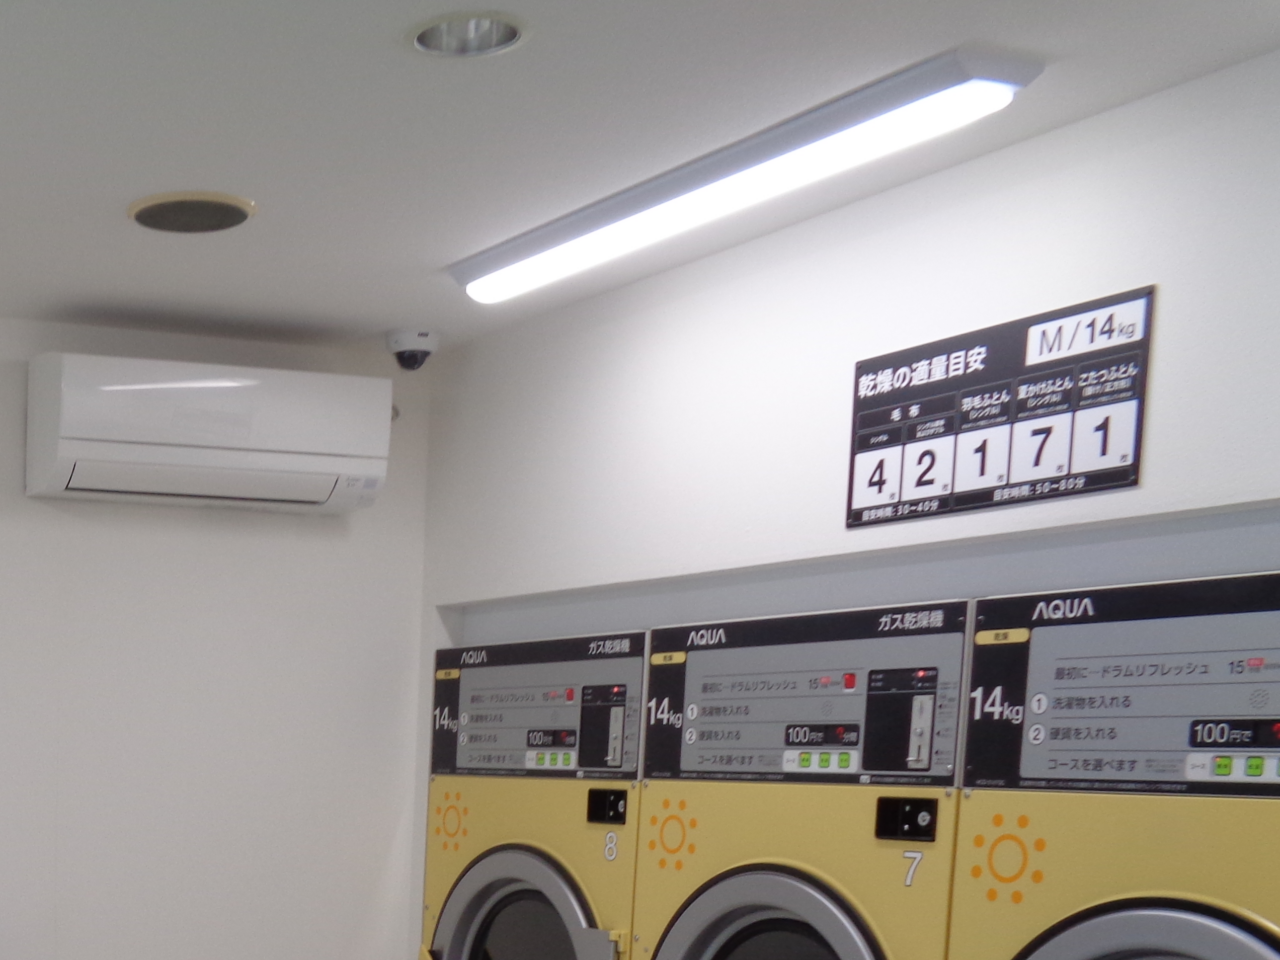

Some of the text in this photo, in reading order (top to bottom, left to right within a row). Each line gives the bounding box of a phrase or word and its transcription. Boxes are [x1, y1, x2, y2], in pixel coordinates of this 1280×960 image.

[858, 346, 987, 399] 乾燥の適量目安
[1078, 362, 1139, 386] こたつふとん
[961, 389, 1011, 411] 羽毛ふとん
[1017, 376, 1074, 399] 夏かけふとん
[1031, 427, 1054, 467] 7
[1094, 416, 1110, 456] 1
[915, 450, 936, 488] 2
[973, 439, 988, 476] 1
[867, 459, 887, 494] 4
[878, 610, 945, 631] ガス乾燥機
[1032, 597, 1095, 621] AQUA
[687, 628, 726, 646] AQUA
[460, 650, 487, 664] AQUA
[1228, 660, 1245, 675] 15
[647, 697, 683, 728] 14kg
[970, 686, 1024, 725] 14kg
[1052, 695, 1132, 711] 洗濯物を入れる
[434, 705, 458, 734] 14kg
[603, 831, 618, 861] 8
[902, 850, 924, 887] 7
